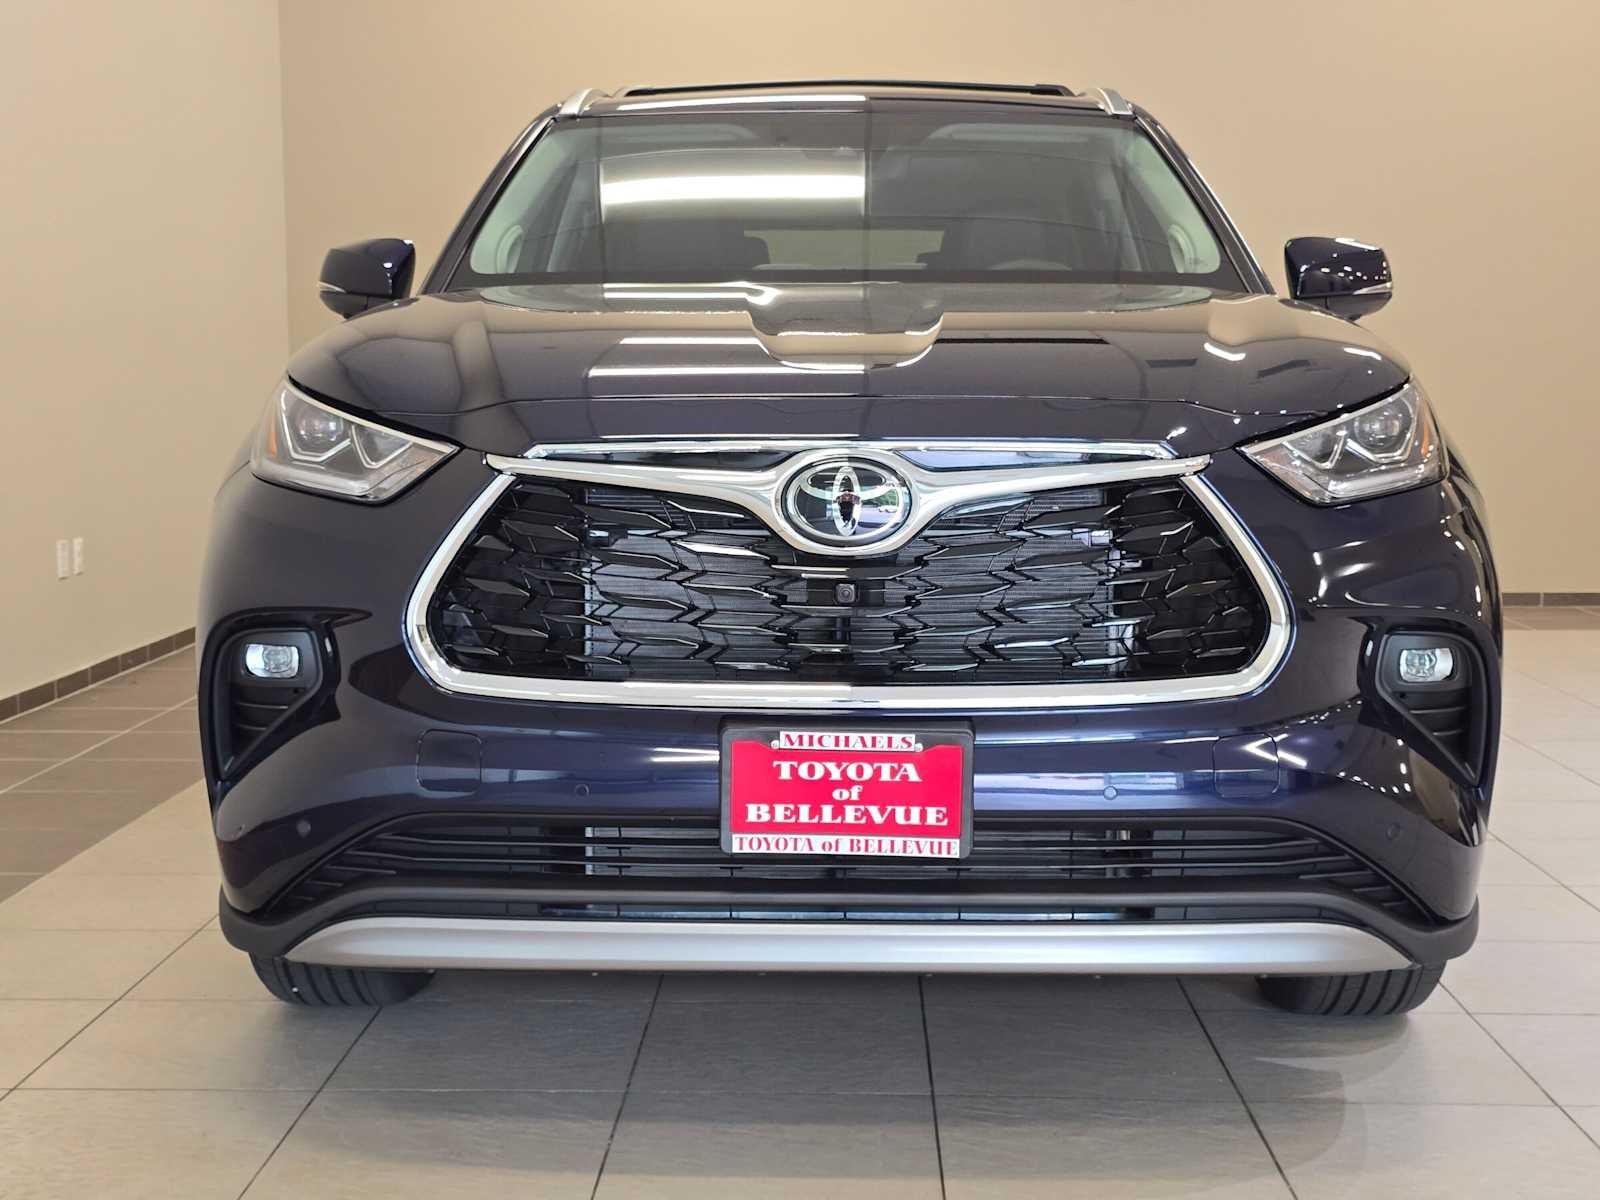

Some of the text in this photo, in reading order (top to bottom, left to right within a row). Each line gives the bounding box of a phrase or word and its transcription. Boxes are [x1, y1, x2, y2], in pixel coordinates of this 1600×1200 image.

[783, 733, 913, 749] MICHAELS
[773, 761, 922, 782] TOYOTA
[832, 785, 863, 801] of
[745, 803, 948, 826] BELLEVUE
[734, 836, 958, 856] TOYOTA of BELLEVUE
